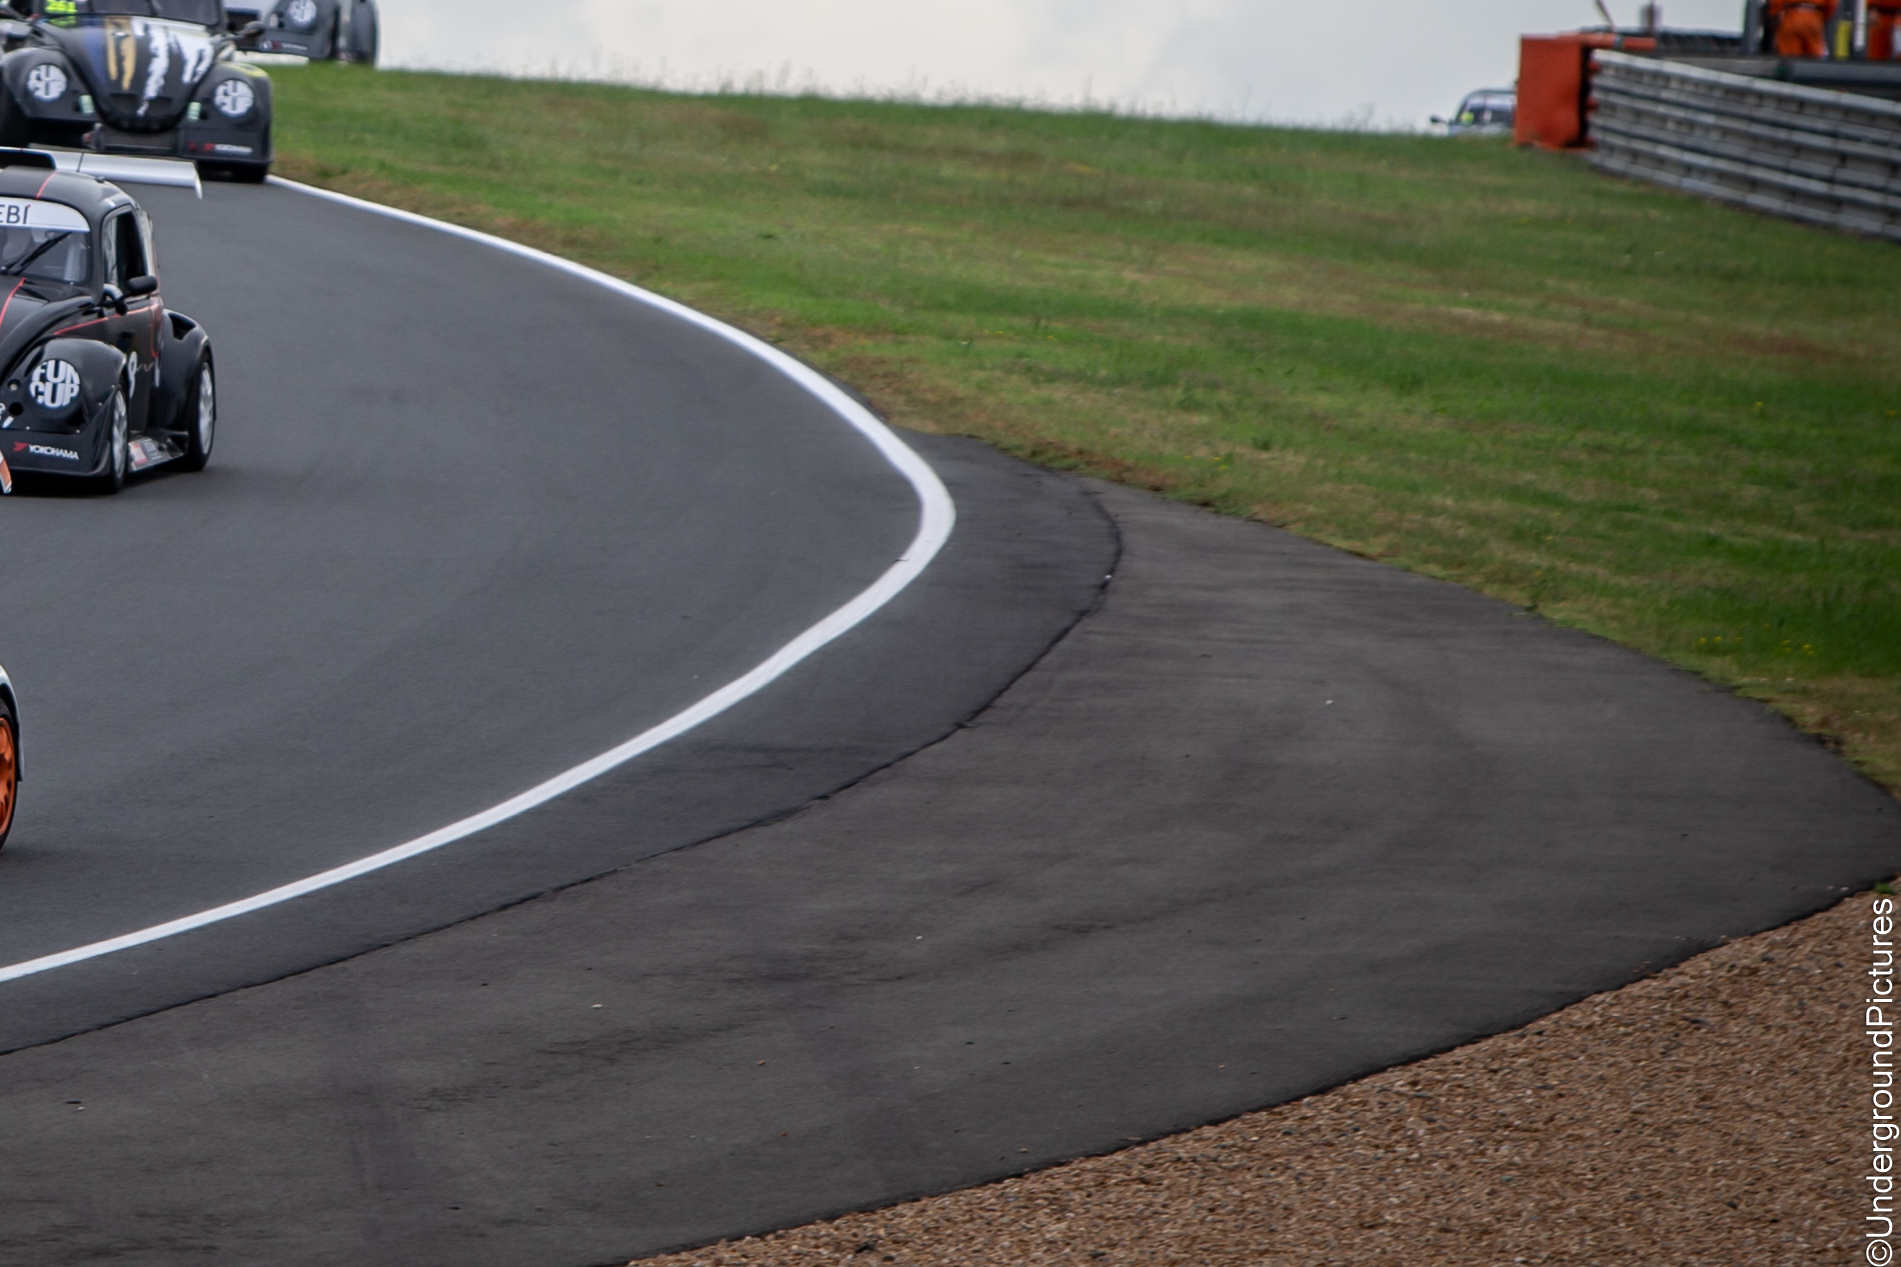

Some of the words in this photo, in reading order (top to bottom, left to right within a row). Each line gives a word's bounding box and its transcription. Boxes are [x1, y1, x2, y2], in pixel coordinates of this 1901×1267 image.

[32, 359, 81, 385] FUN
[29, 381, 80, 408] CUP
[29, 444, 80, 460] YOKOHAMA
